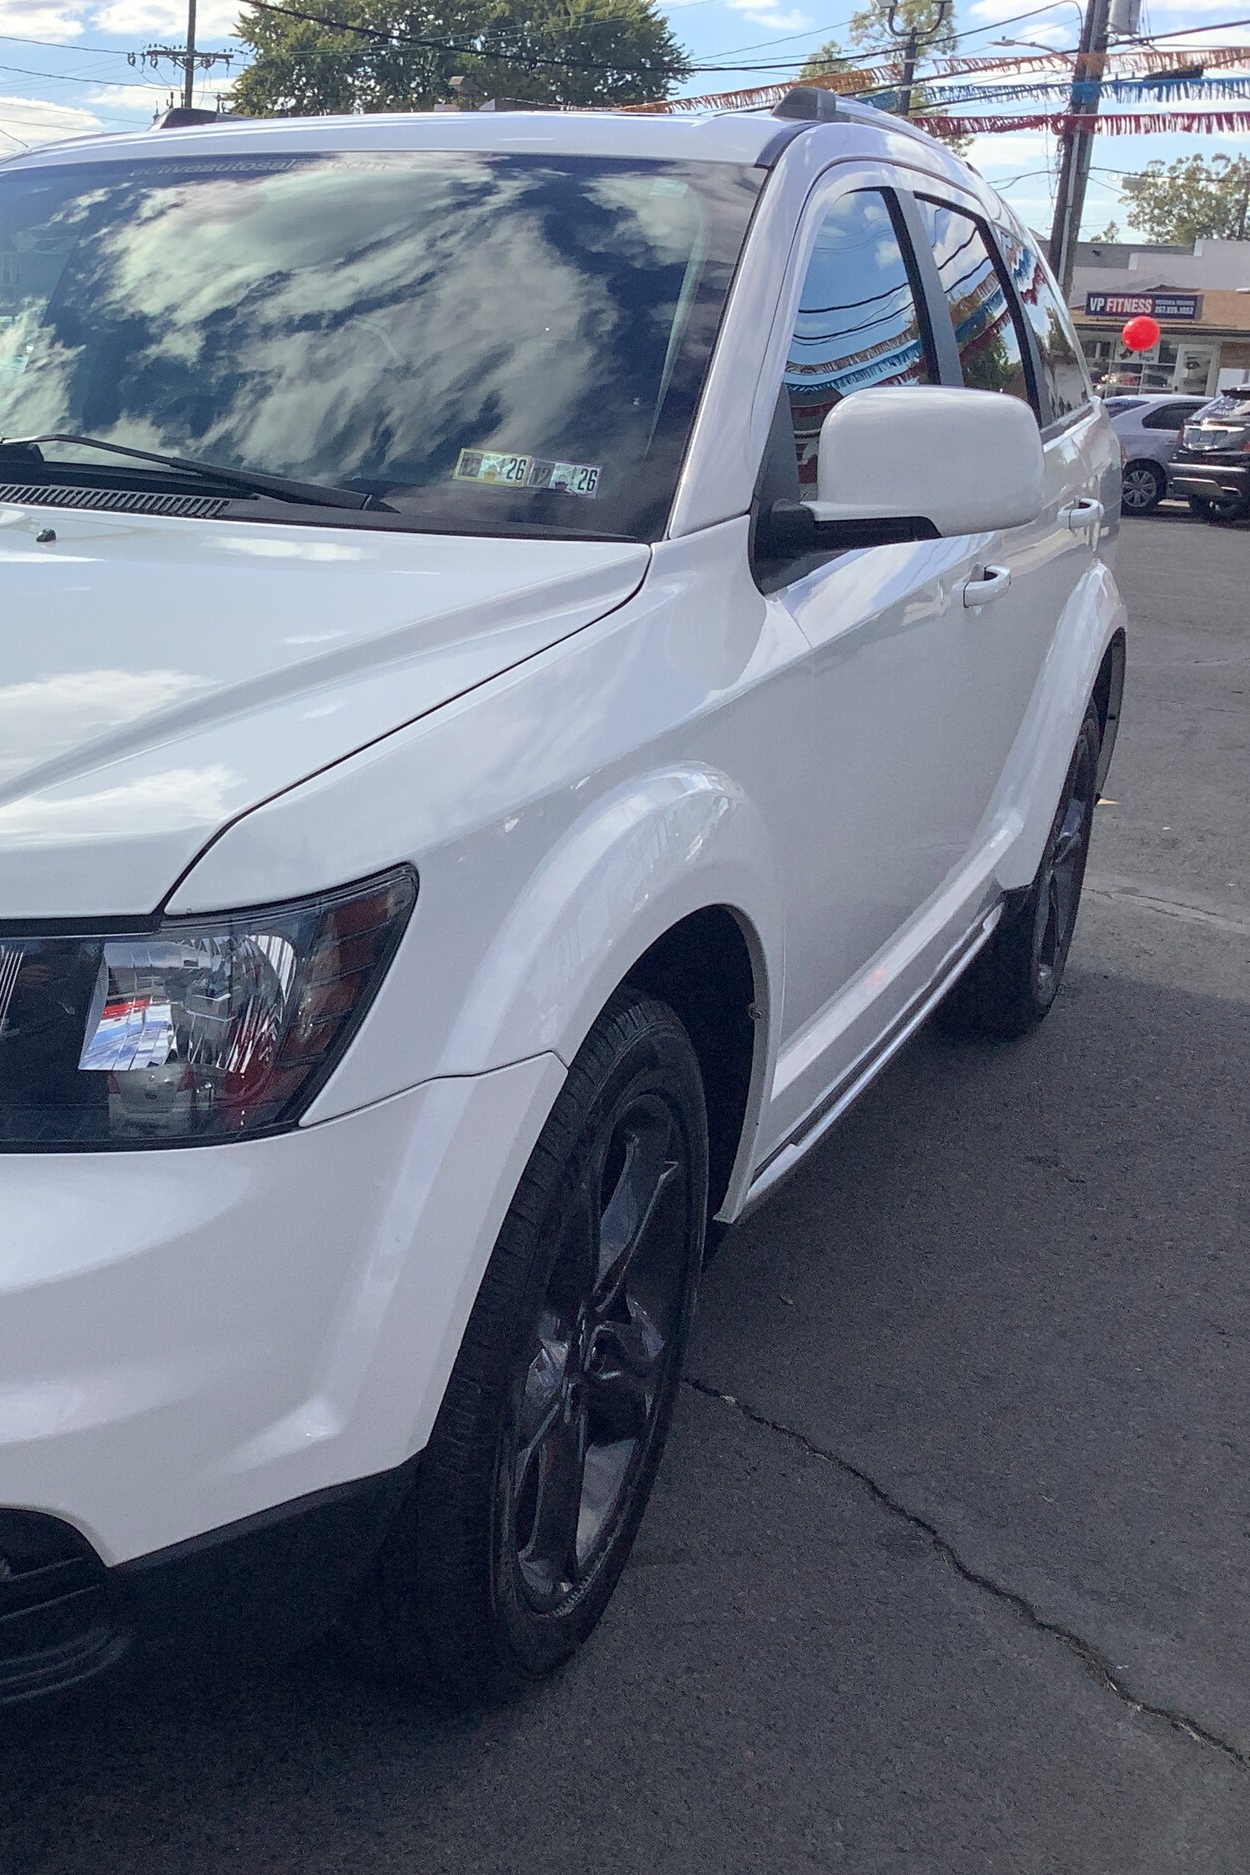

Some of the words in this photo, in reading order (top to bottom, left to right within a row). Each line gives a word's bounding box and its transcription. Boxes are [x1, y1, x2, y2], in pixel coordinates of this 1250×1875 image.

[1090, 297, 1105, 312] VP
[1106, 298, 1153, 313] FITNESS
[506, 458, 526, 480] 26
[577, 468, 598, 492] 26
